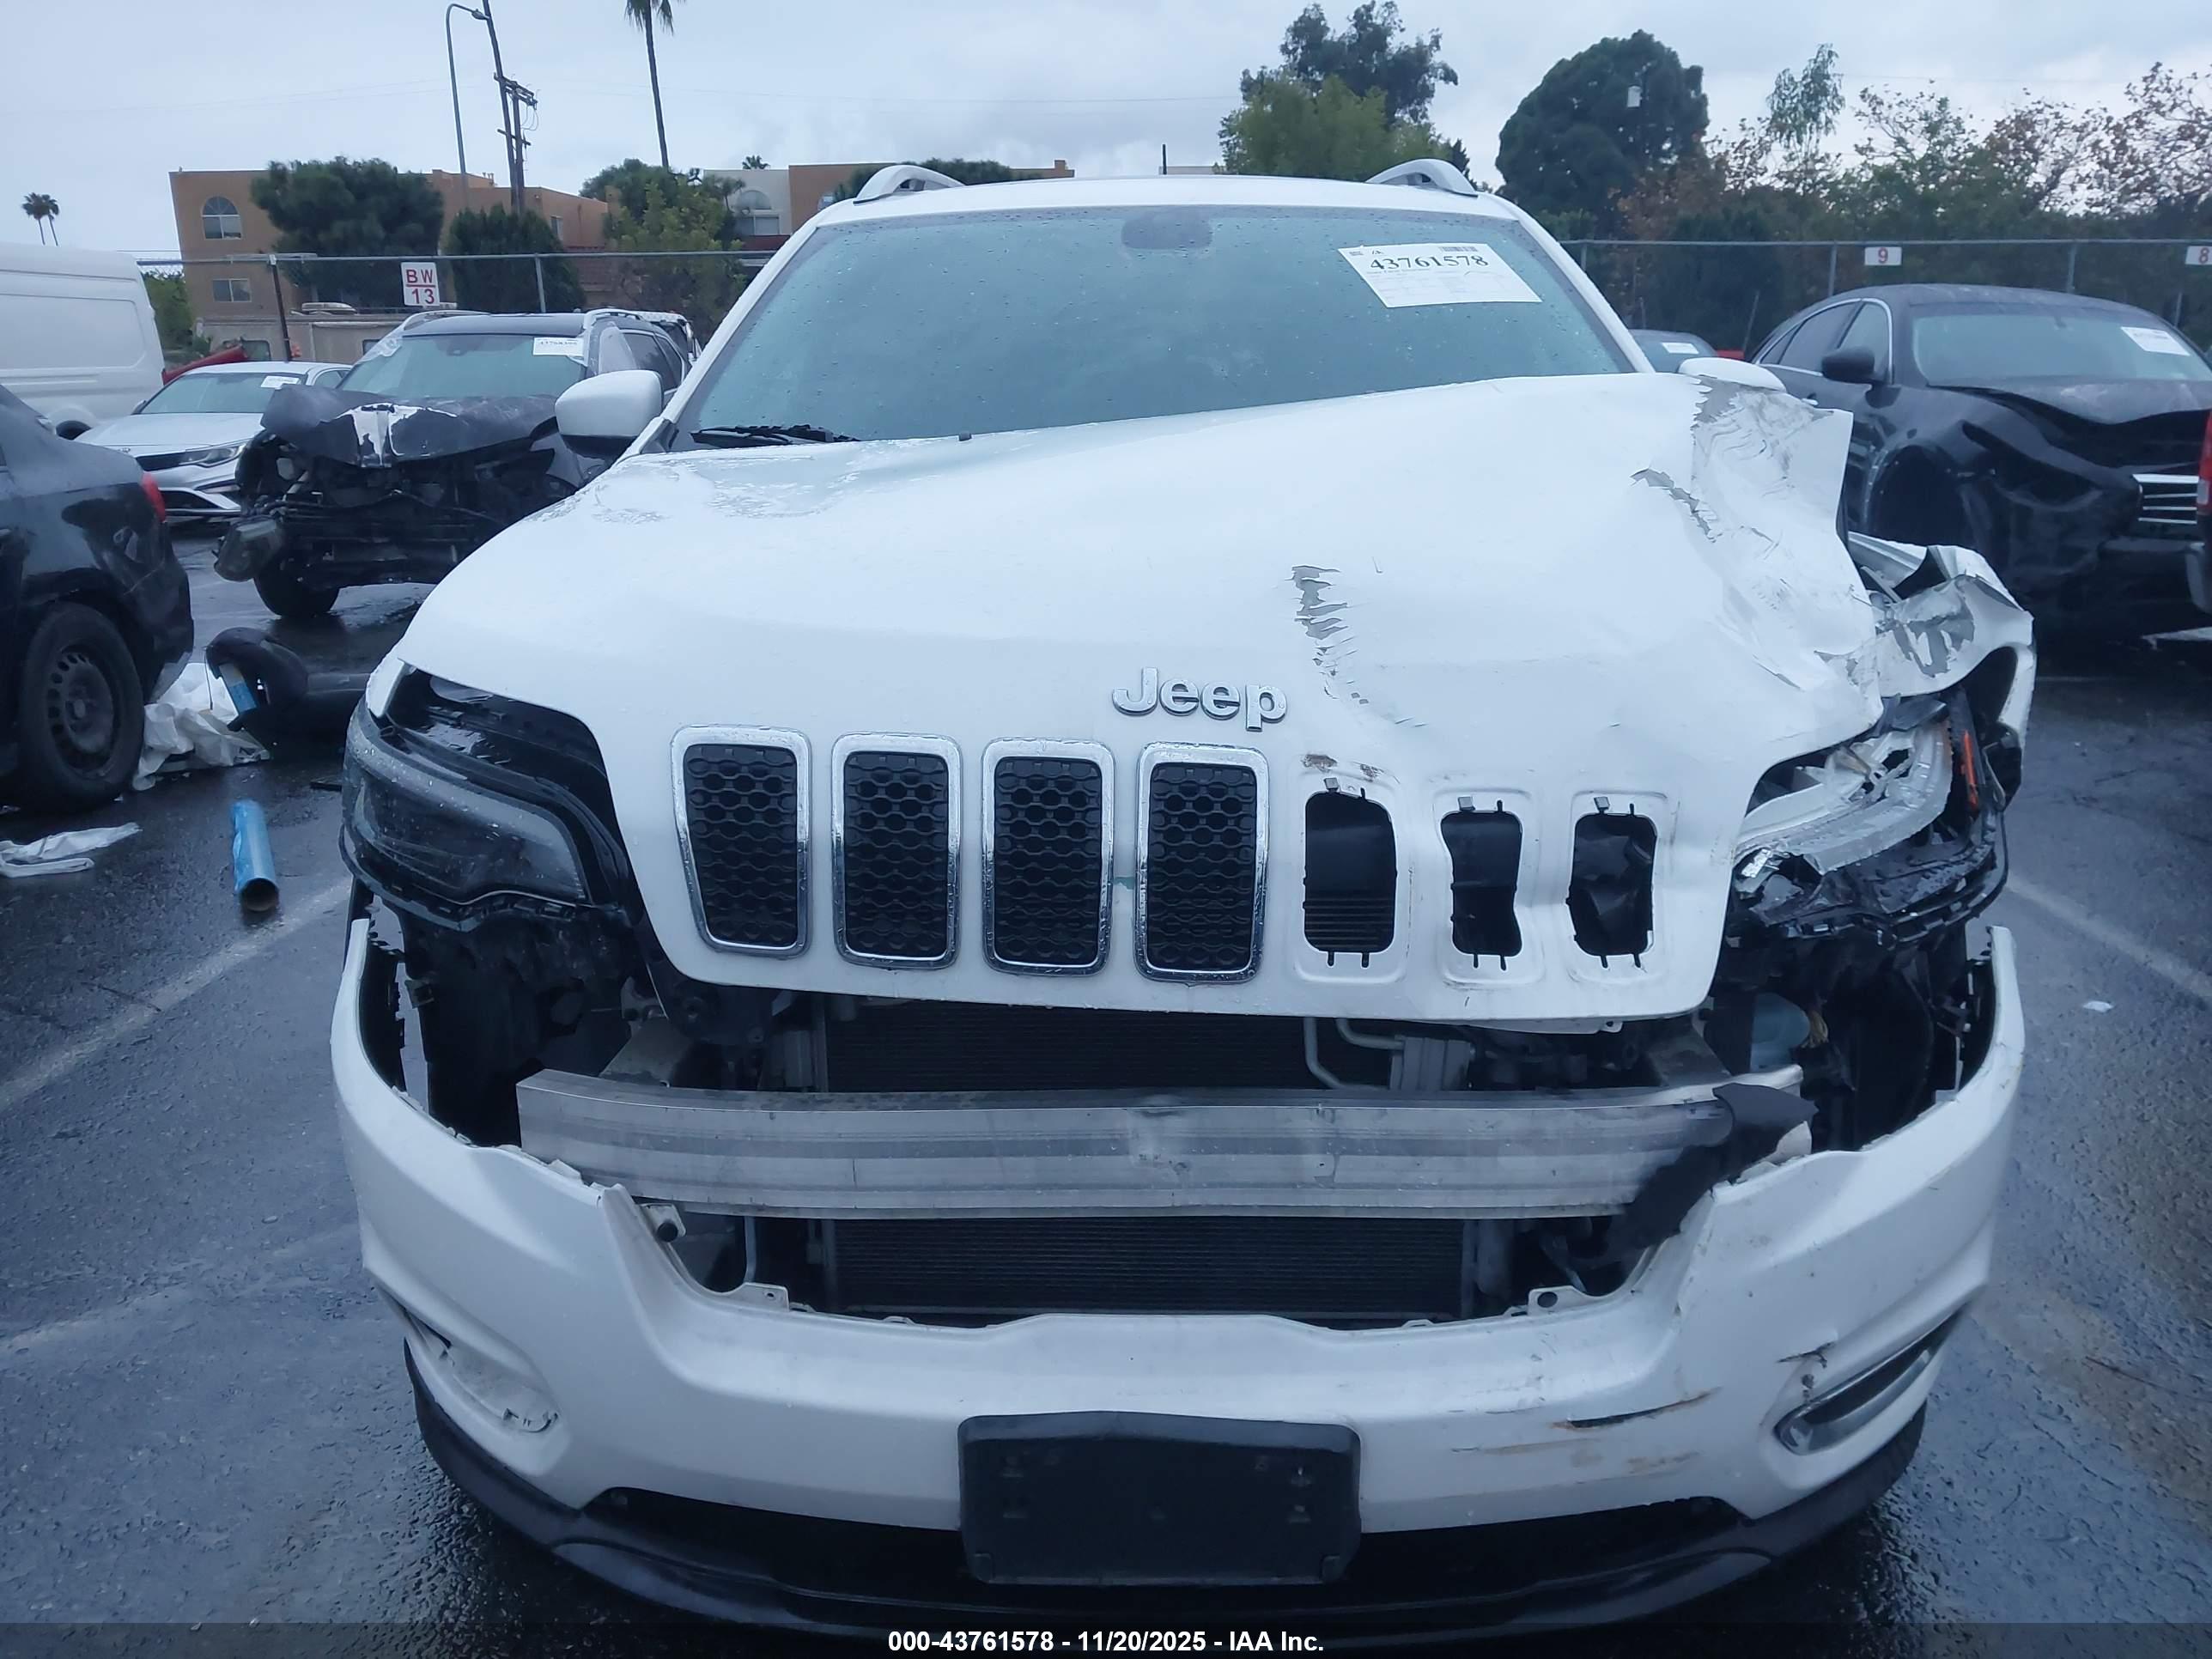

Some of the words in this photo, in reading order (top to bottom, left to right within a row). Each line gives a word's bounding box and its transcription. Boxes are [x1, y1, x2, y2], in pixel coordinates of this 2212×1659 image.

[1370, 255, 1489, 270] 43761578
[1878, 247, 1888, 264] 9
[2199, 247, 2209, 264] 8
[405, 269, 433, 283] BW
[412, 288, 434, 304] 13
[1112, 666, 1287, 732] Jeep
